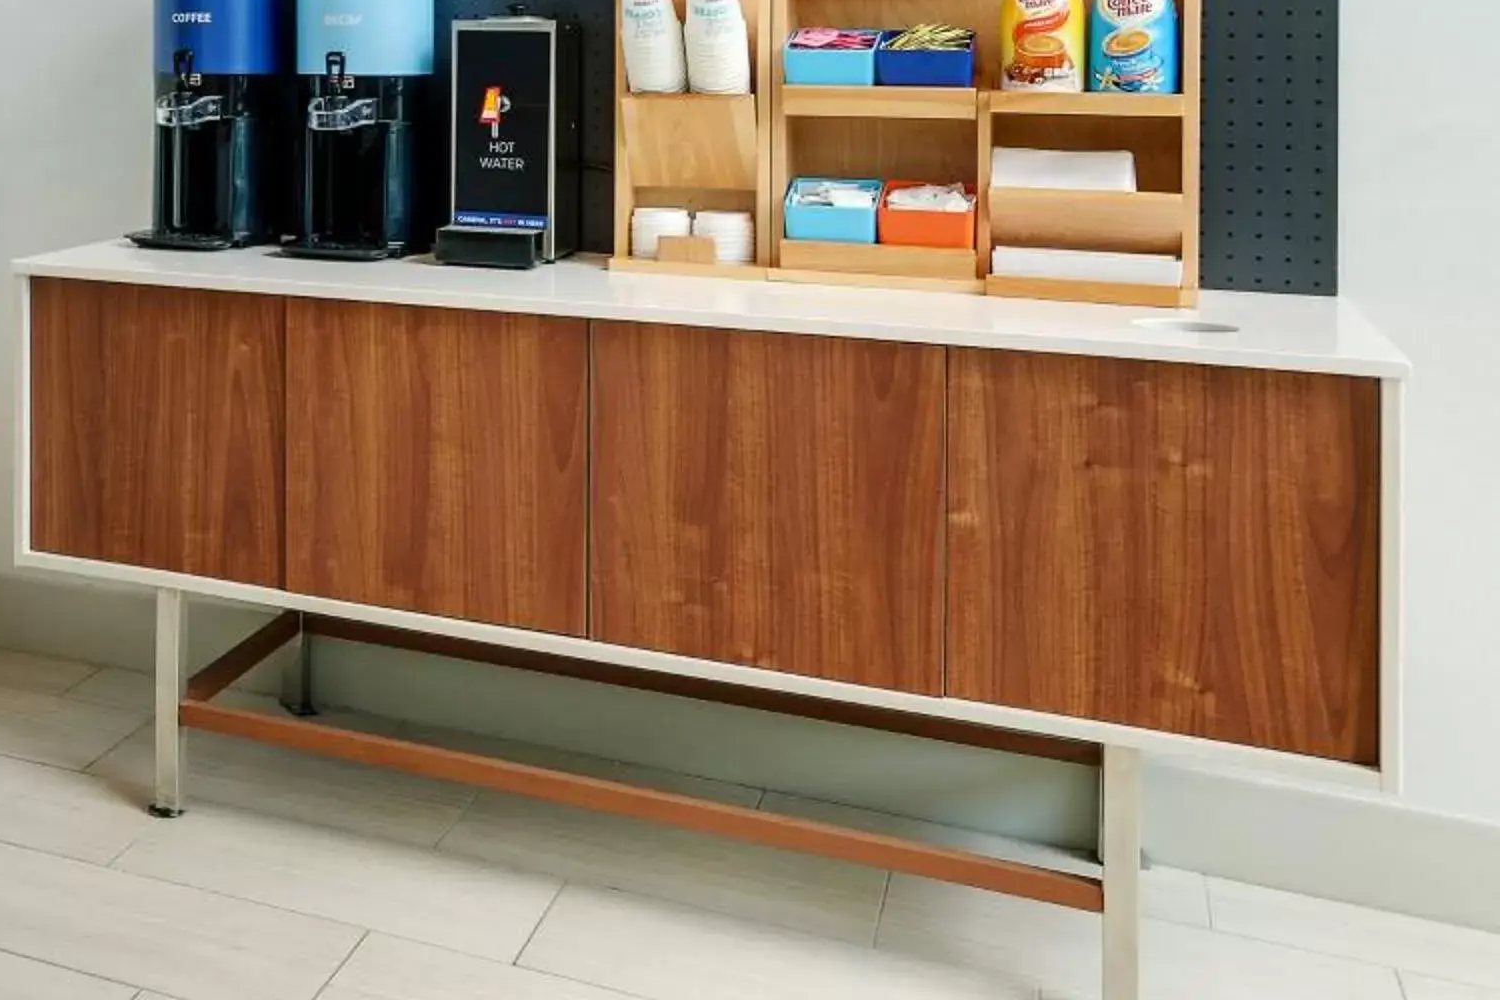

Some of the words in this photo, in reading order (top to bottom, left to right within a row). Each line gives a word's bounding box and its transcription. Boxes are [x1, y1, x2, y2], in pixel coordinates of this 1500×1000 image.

[171, 11, 213, 25] COFFEE
[489, 141, 516, 154] HOT
[479, 157, 525, 171] WATER
